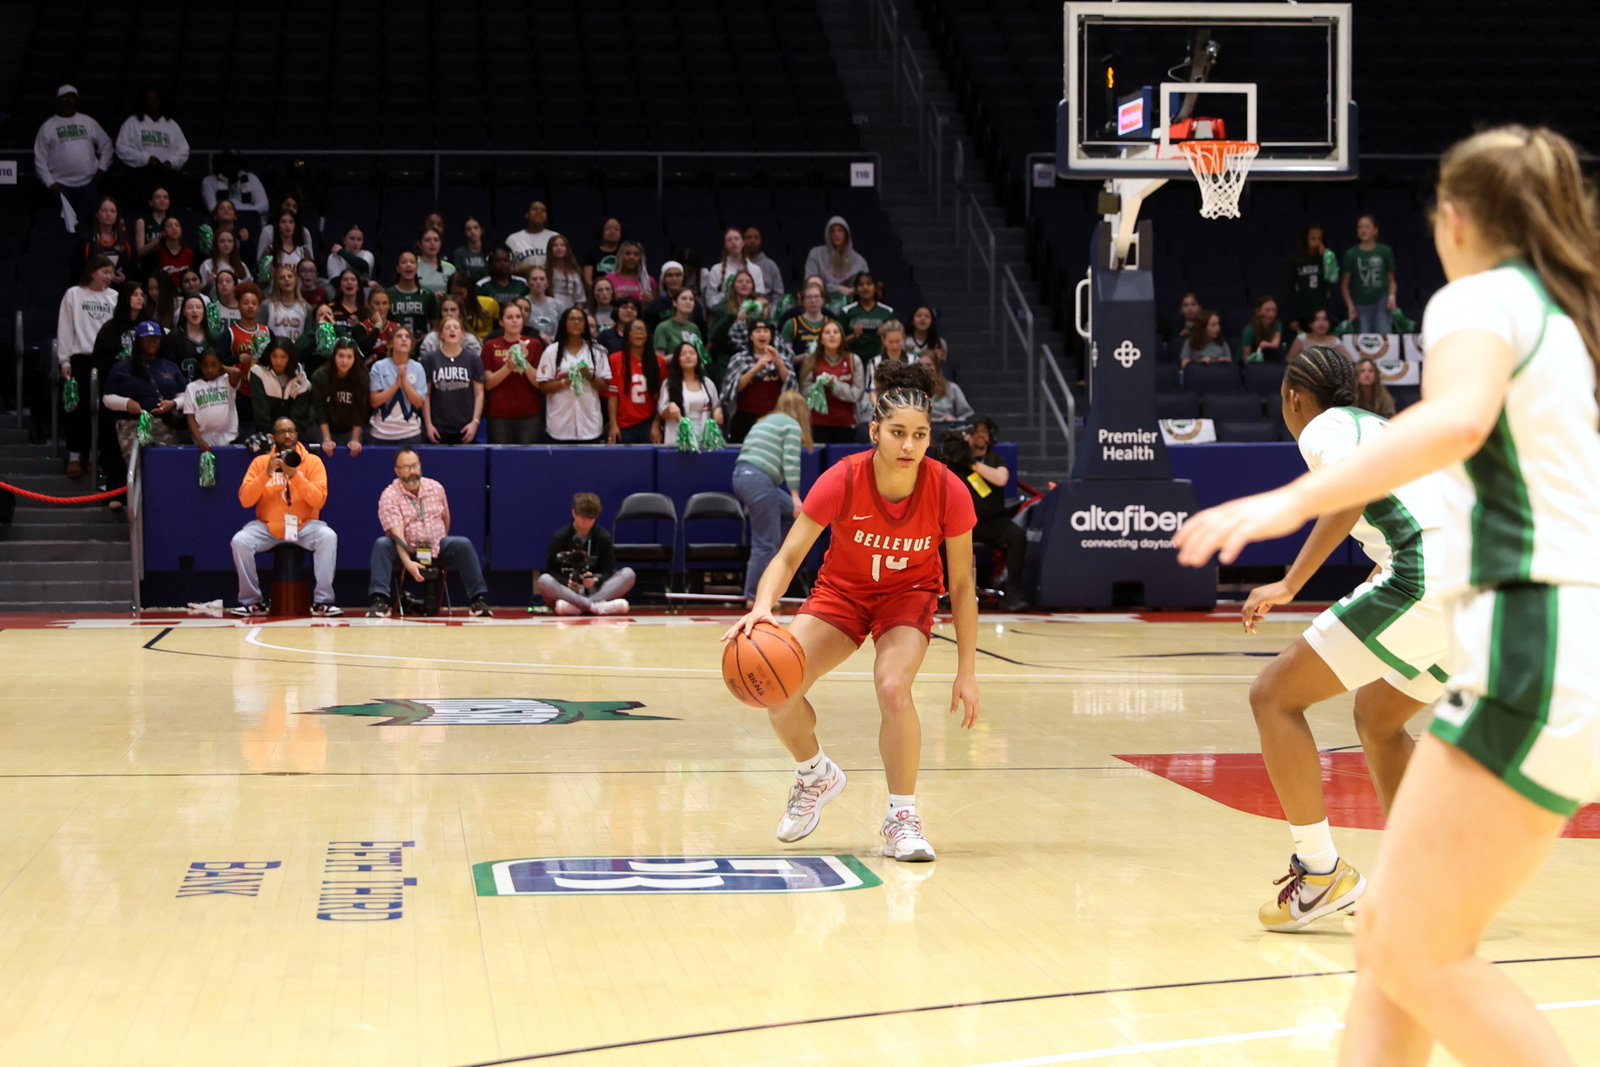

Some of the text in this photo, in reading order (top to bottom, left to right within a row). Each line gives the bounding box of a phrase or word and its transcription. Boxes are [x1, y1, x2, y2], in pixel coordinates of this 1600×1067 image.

[855, 170, 869, 179] 116
[391, 301, 424, 315] LAUREL
[432, 366, 470, 383] LAUREL
[631, 373, 647, 404] 2
[195, 391, 229, 406] MOMENT
[1098, 428, 1158, 444] Premier
[1102, 446, 1155, 461] Health
[1070, 505, 1188, 537] altafiber
[853, 529, 932, 551] BELLEVUE
[1080, 538, 1138, 551] connecting
[871, 553, 909, 582] 14
[175, 860, 283, 898] BANK
[316, 840, 417, 922] FIFTH THIRD
